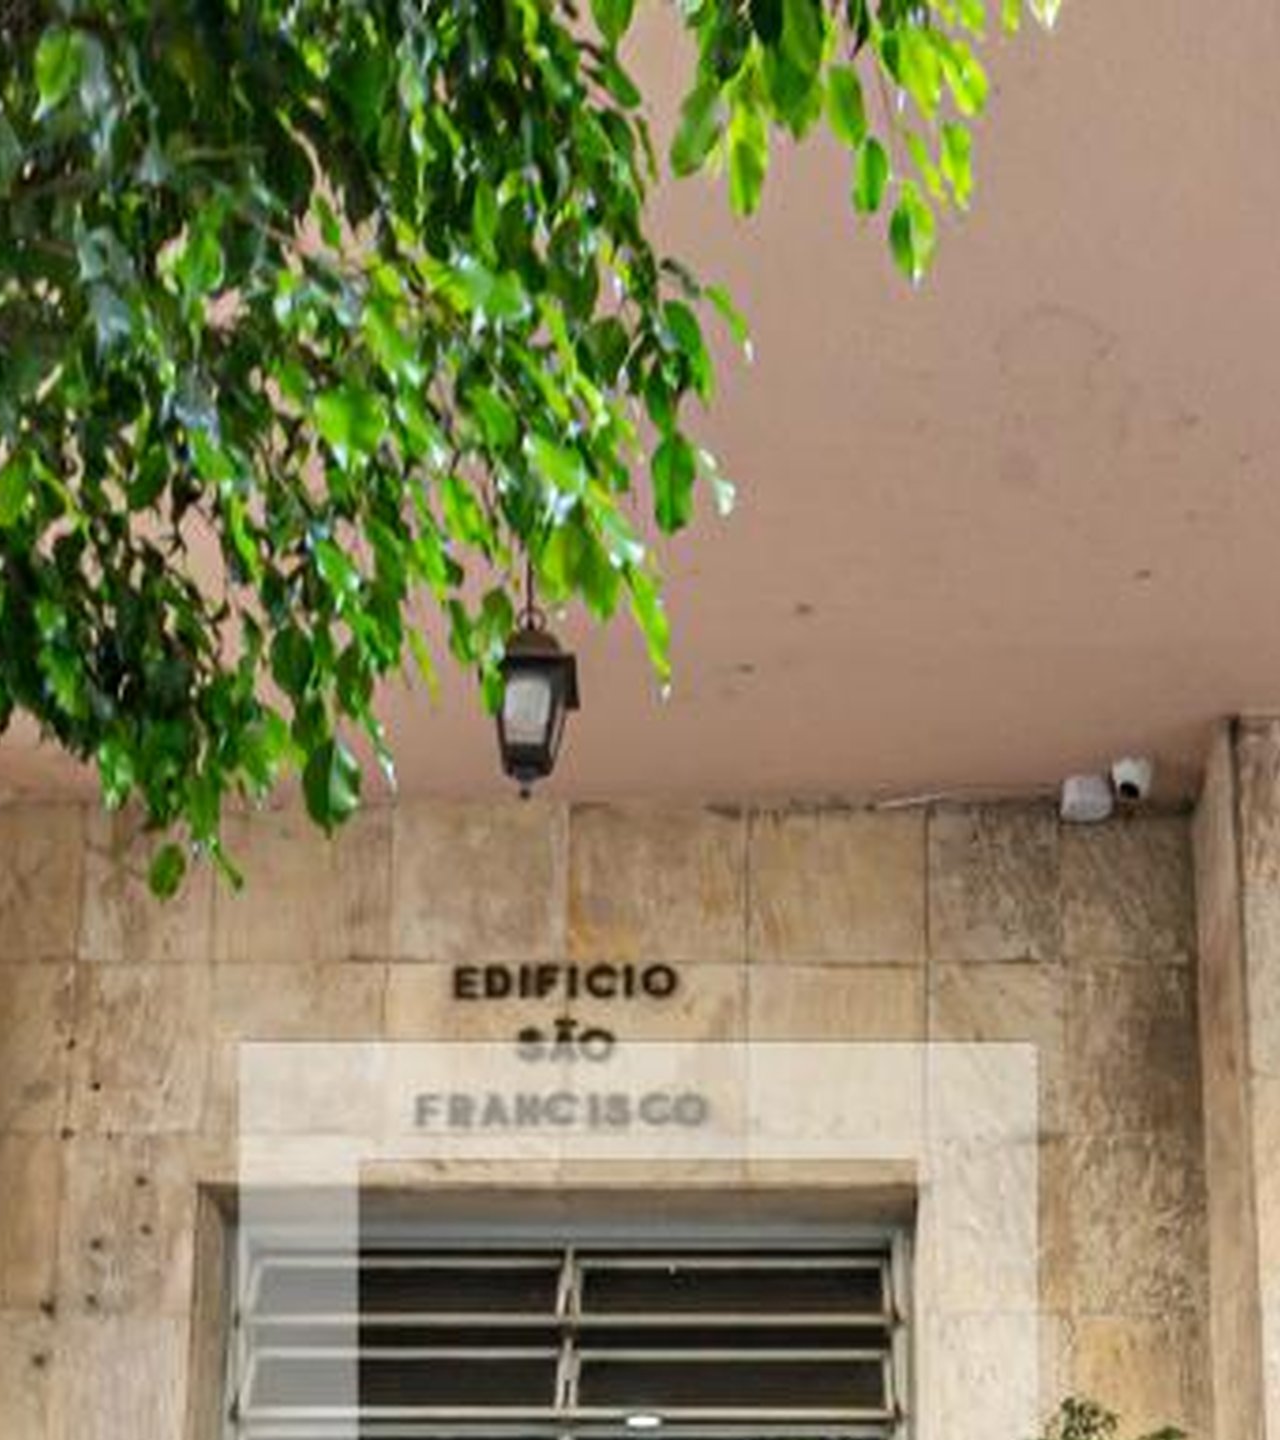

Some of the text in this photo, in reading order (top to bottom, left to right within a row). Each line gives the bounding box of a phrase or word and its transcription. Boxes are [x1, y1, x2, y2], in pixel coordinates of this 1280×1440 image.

[452, 963, 678, 1000] EDIFICIO
[517, 1018, 617, 1063] SÃO
[414, 1092, 710, 1128] FRANCISCO
